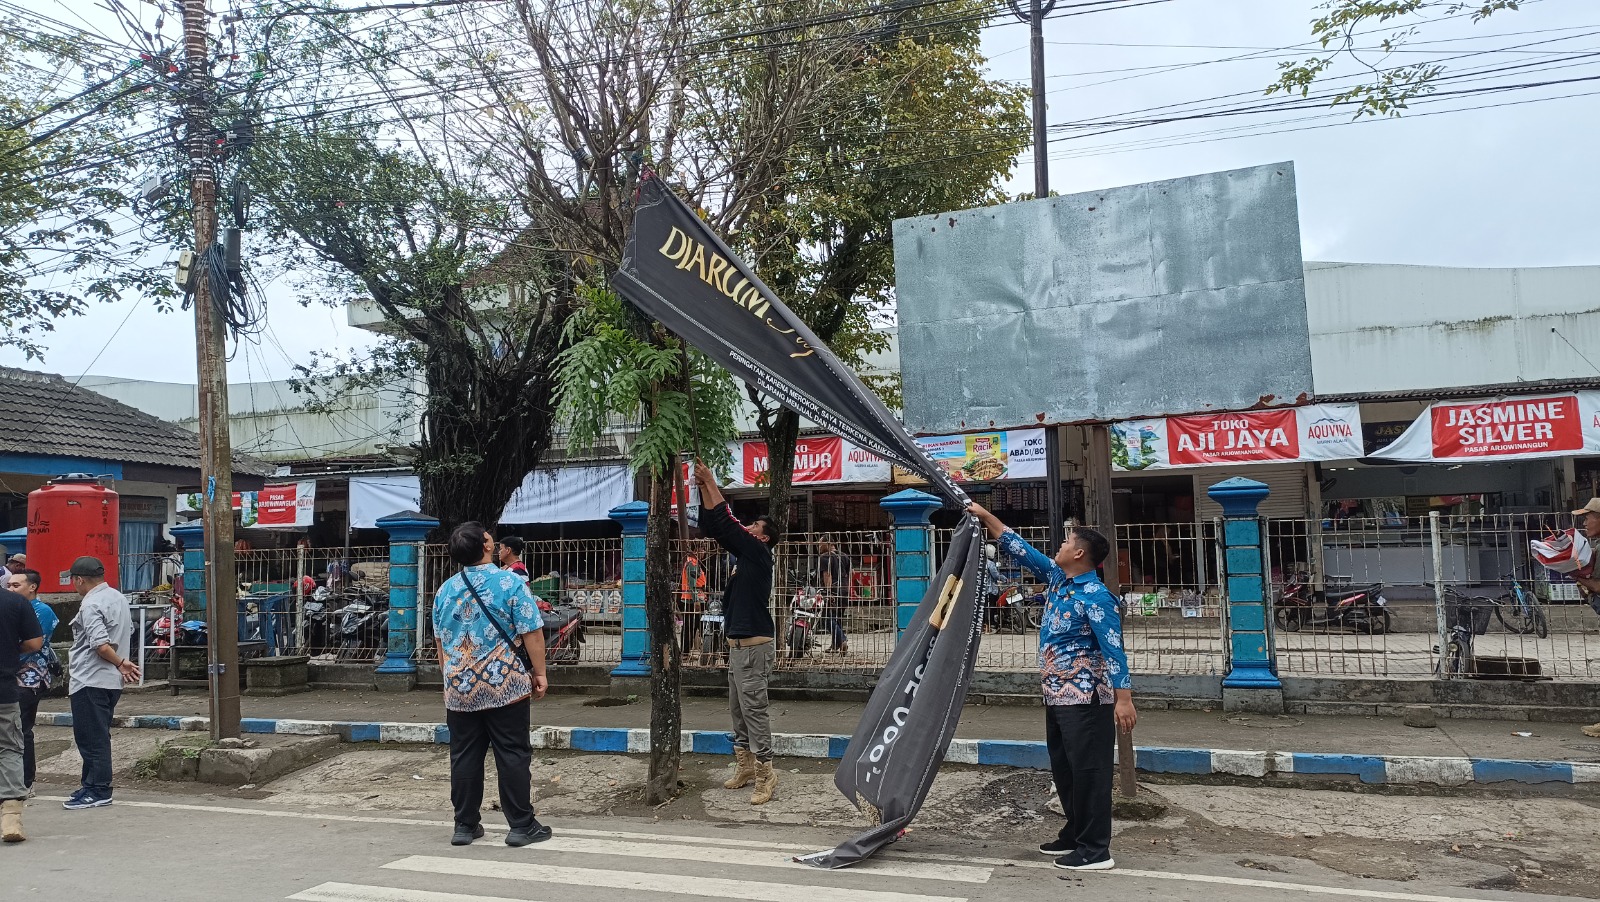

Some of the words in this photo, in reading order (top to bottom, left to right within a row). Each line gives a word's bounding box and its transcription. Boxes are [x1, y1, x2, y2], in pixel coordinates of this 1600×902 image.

[658, 225, 772, 320] DJARUM
[729, 350, 765, 378] PERINGATAN:
[765, 373, 789, 394] KARENA
[789, 389, 820, 415] MEROKOK,
[820, 409, 838, 425] SAYA
[838, 420, 868, 443] TERKENA
[757, 377, 786, 401] DILARANG
[785, 395, 813, 419] MENJUAL
[813, 414, 828, 428] DAN
[1211, 419, 1249, 431] TOKO
[1445, 401, 1565, 427] JASMINE
[1023, 438, 1043, 447] TOKO
[1177, 432, 1216, 452] AJI
[1223, 427, 1290, 450] JAYA
[1308, 423, 1353, 440] AQUVIVA
[1459, 421, 1554, 445] SILVER
[972, 442, 993, 453] Racik
[1009, 447, 1047, 457] ABADI/BO
[753, 452, 832, 473] MMUR
